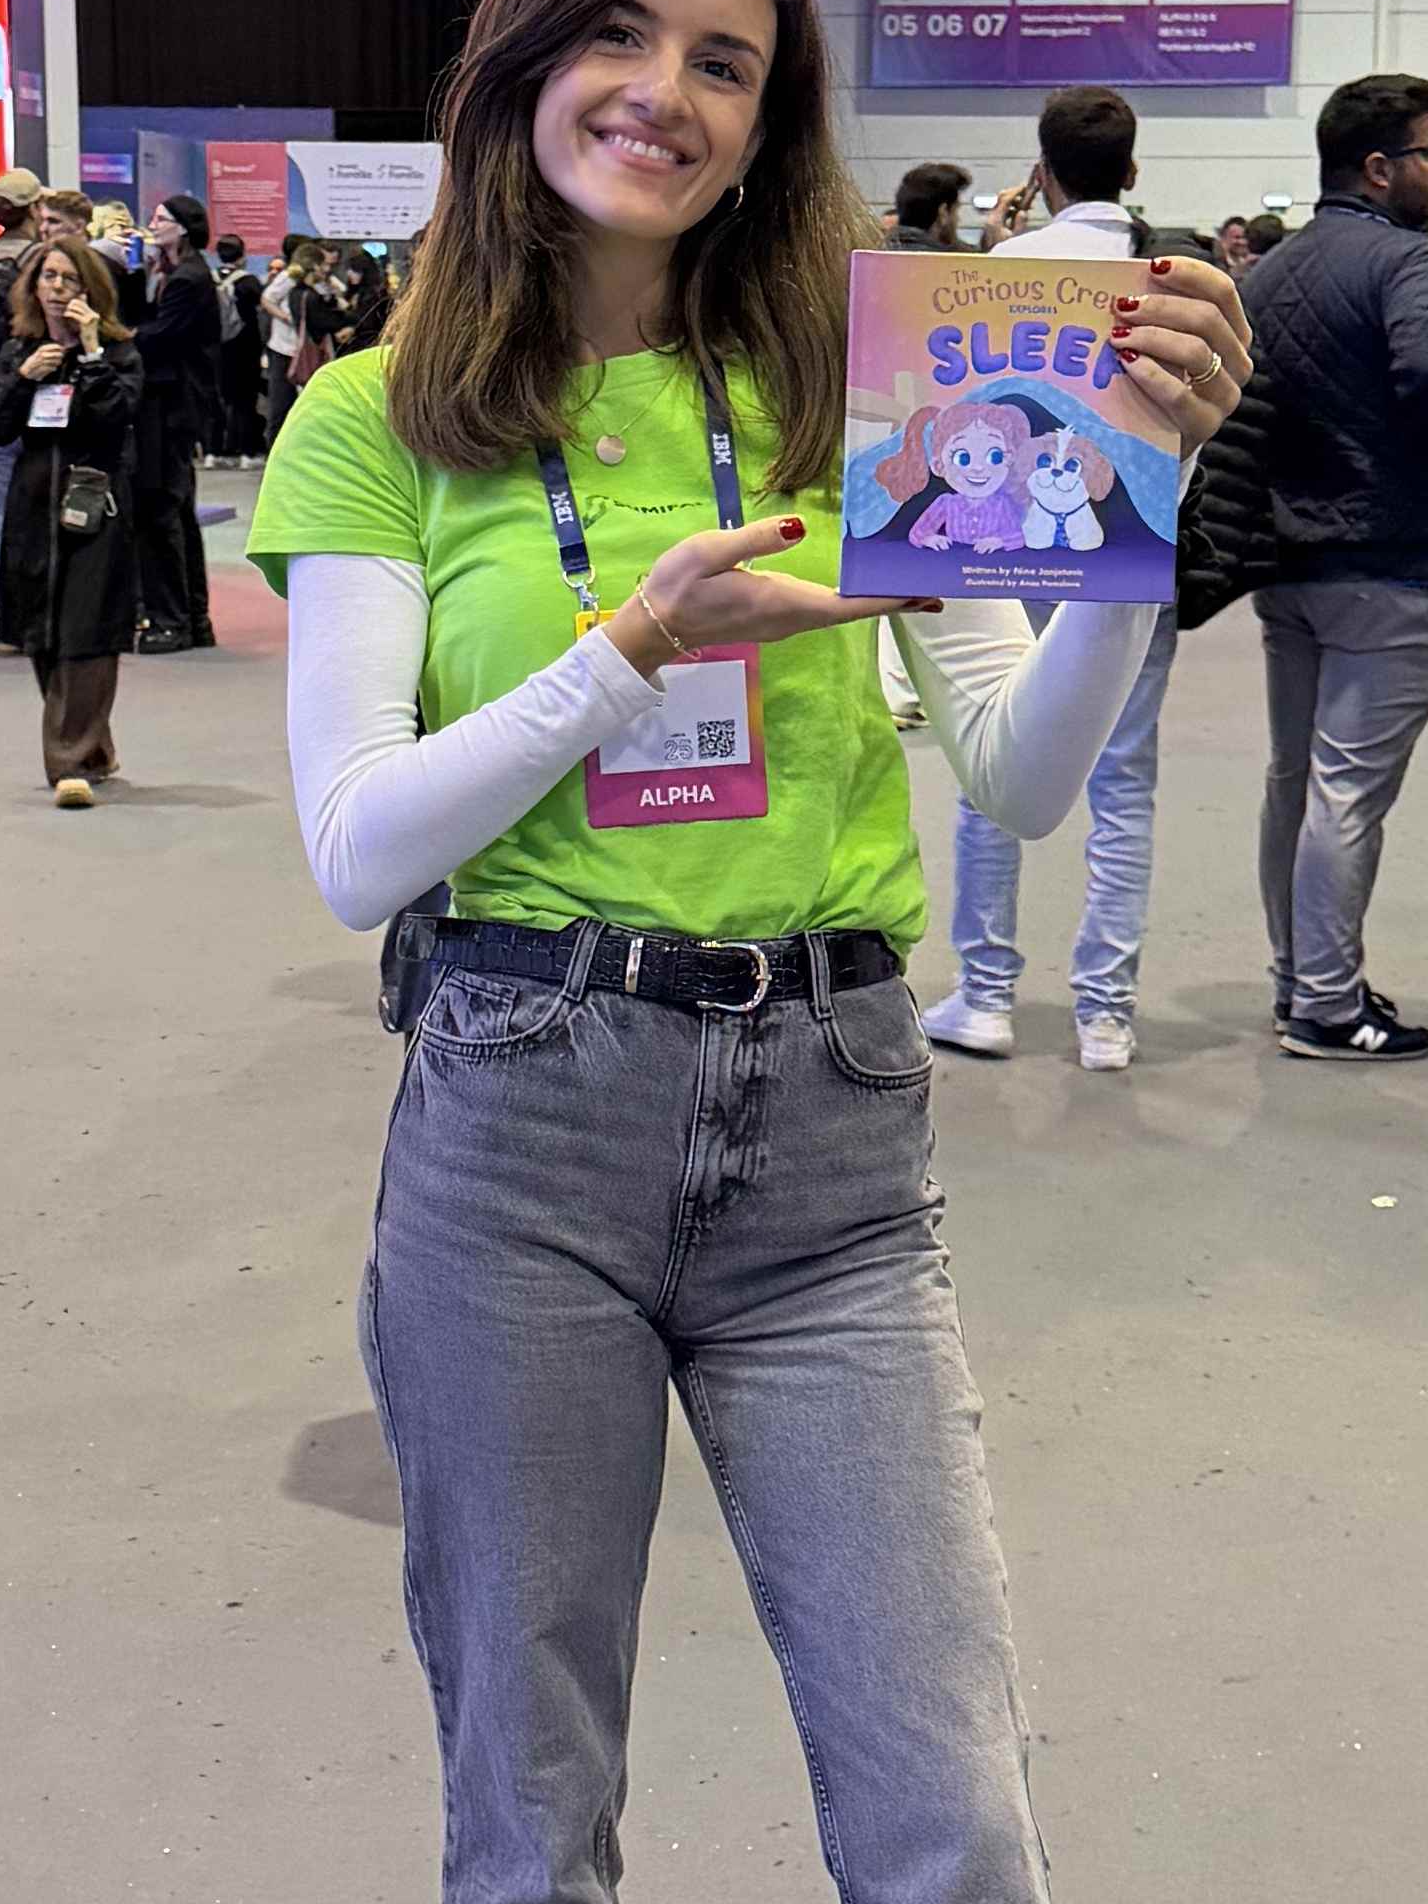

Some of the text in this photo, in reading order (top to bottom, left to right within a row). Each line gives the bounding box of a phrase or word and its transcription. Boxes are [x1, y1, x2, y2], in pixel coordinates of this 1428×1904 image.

[881, 13, 1009, 37] 05 06 07
[952, 268, 979, 286] The
[931, 277, 1045, 315] Curious
[712, 432, 732, 465] IBM
[551, 490, 574, 525] IBM
[664, 738, 695, 763] 25
[639, 783, 716, 808] ALPHA
